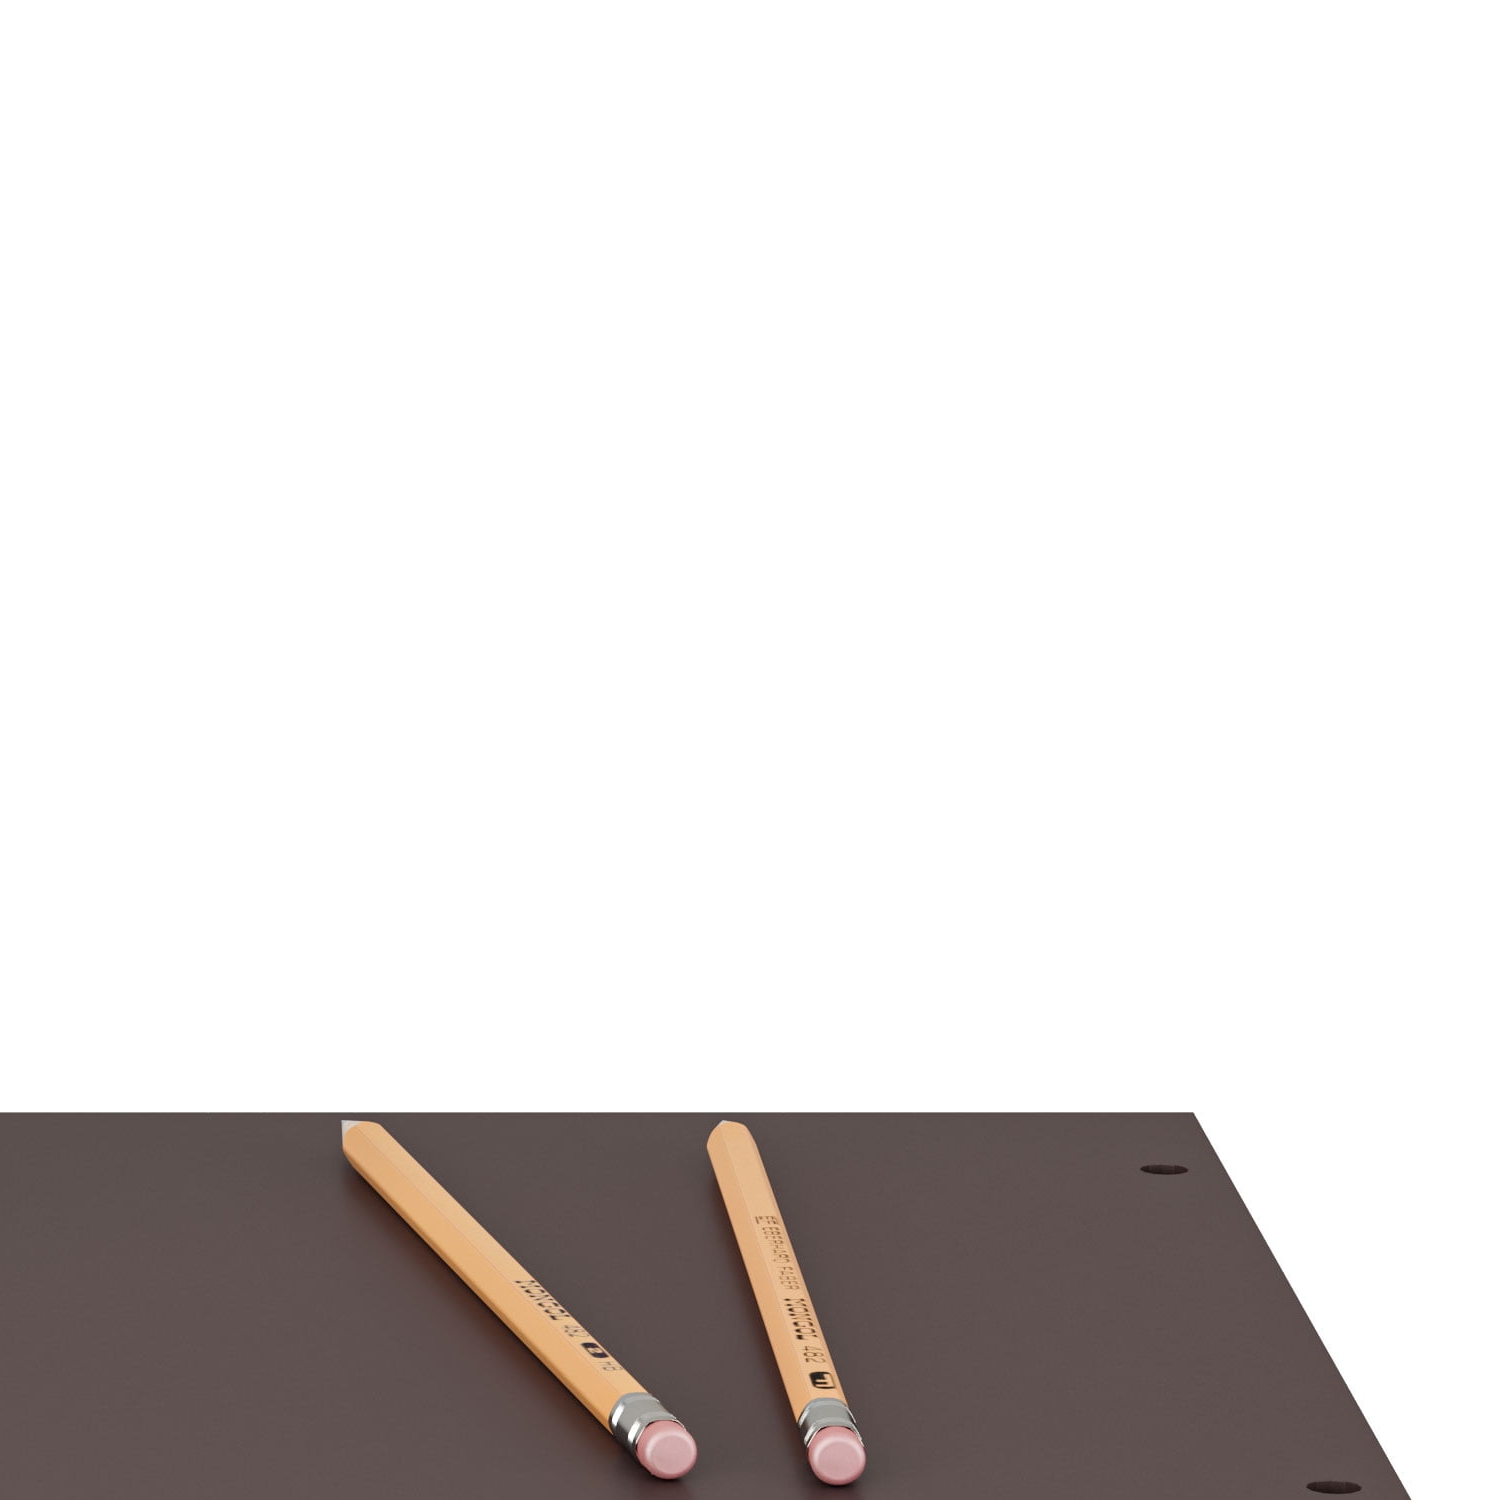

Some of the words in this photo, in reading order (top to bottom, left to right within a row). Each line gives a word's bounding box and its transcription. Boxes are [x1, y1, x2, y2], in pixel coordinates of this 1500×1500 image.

[762, 1226, 791, 1263] EBERHARD
[776, 1266, 800, 1290] FABER
[515, 1280, 570, 1320] MONGOL
[784, 1298, 818, 1340] MONGOL
[801, 1345, 827, 1363] 482
